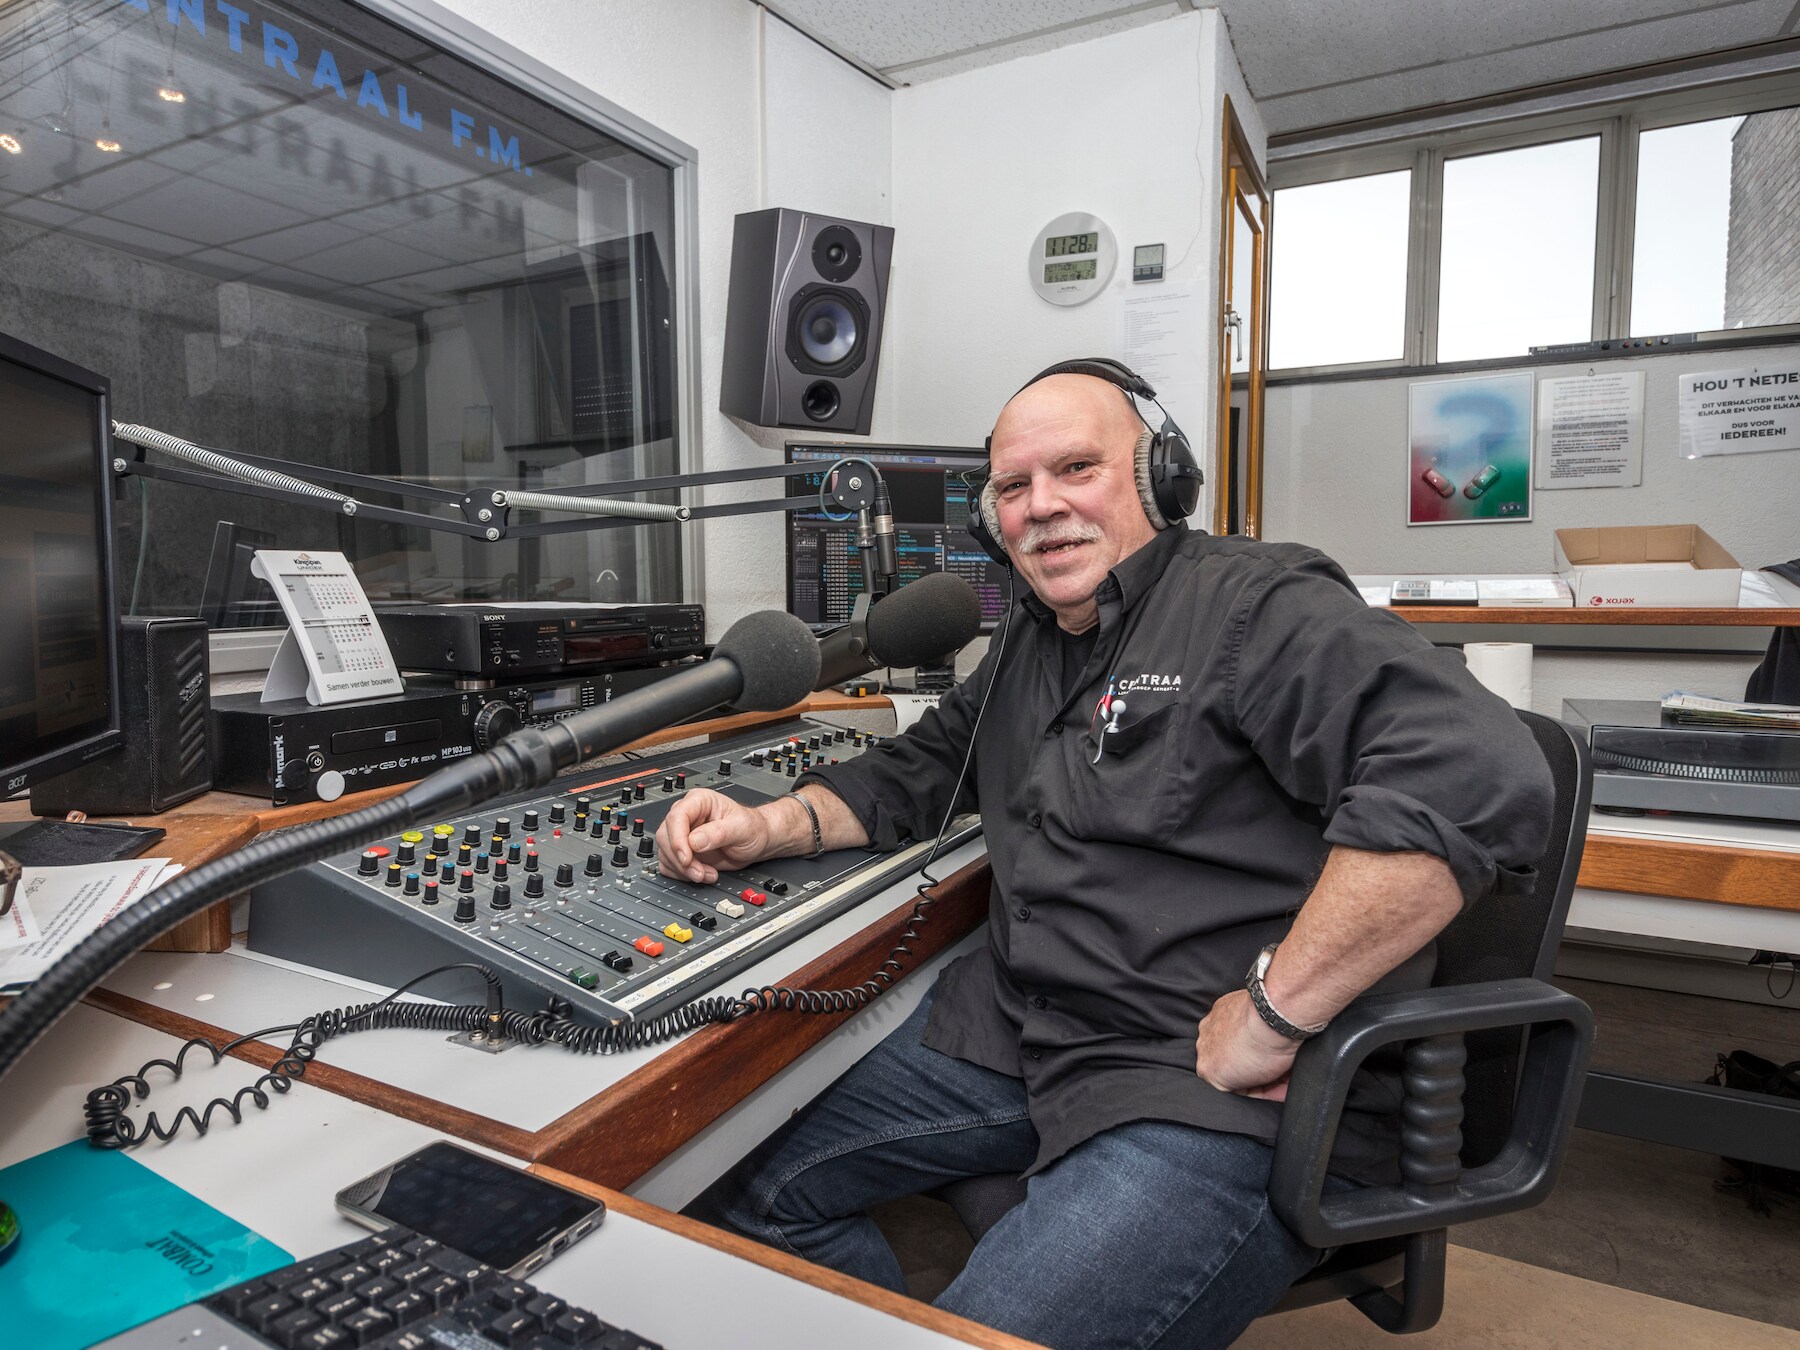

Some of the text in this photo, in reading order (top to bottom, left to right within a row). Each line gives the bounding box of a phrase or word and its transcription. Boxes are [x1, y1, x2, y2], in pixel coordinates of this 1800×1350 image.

[128, 0, 422, 131] NTRAAL
[1693, 380, 1728, 393] HOU
[1750, 372, 1800, 387] NETJE
[1698, 408, 1732, 417] ELKAAR
[1747, 405, 1771, 413] VOOR
[1731, 421, 1748, 429] DUS
[1720, 427, 1787, 440] IEDEREEN!
[327, 677, 394, 691] Samen verder bouwen
[8, 774, 28, 791] acer
